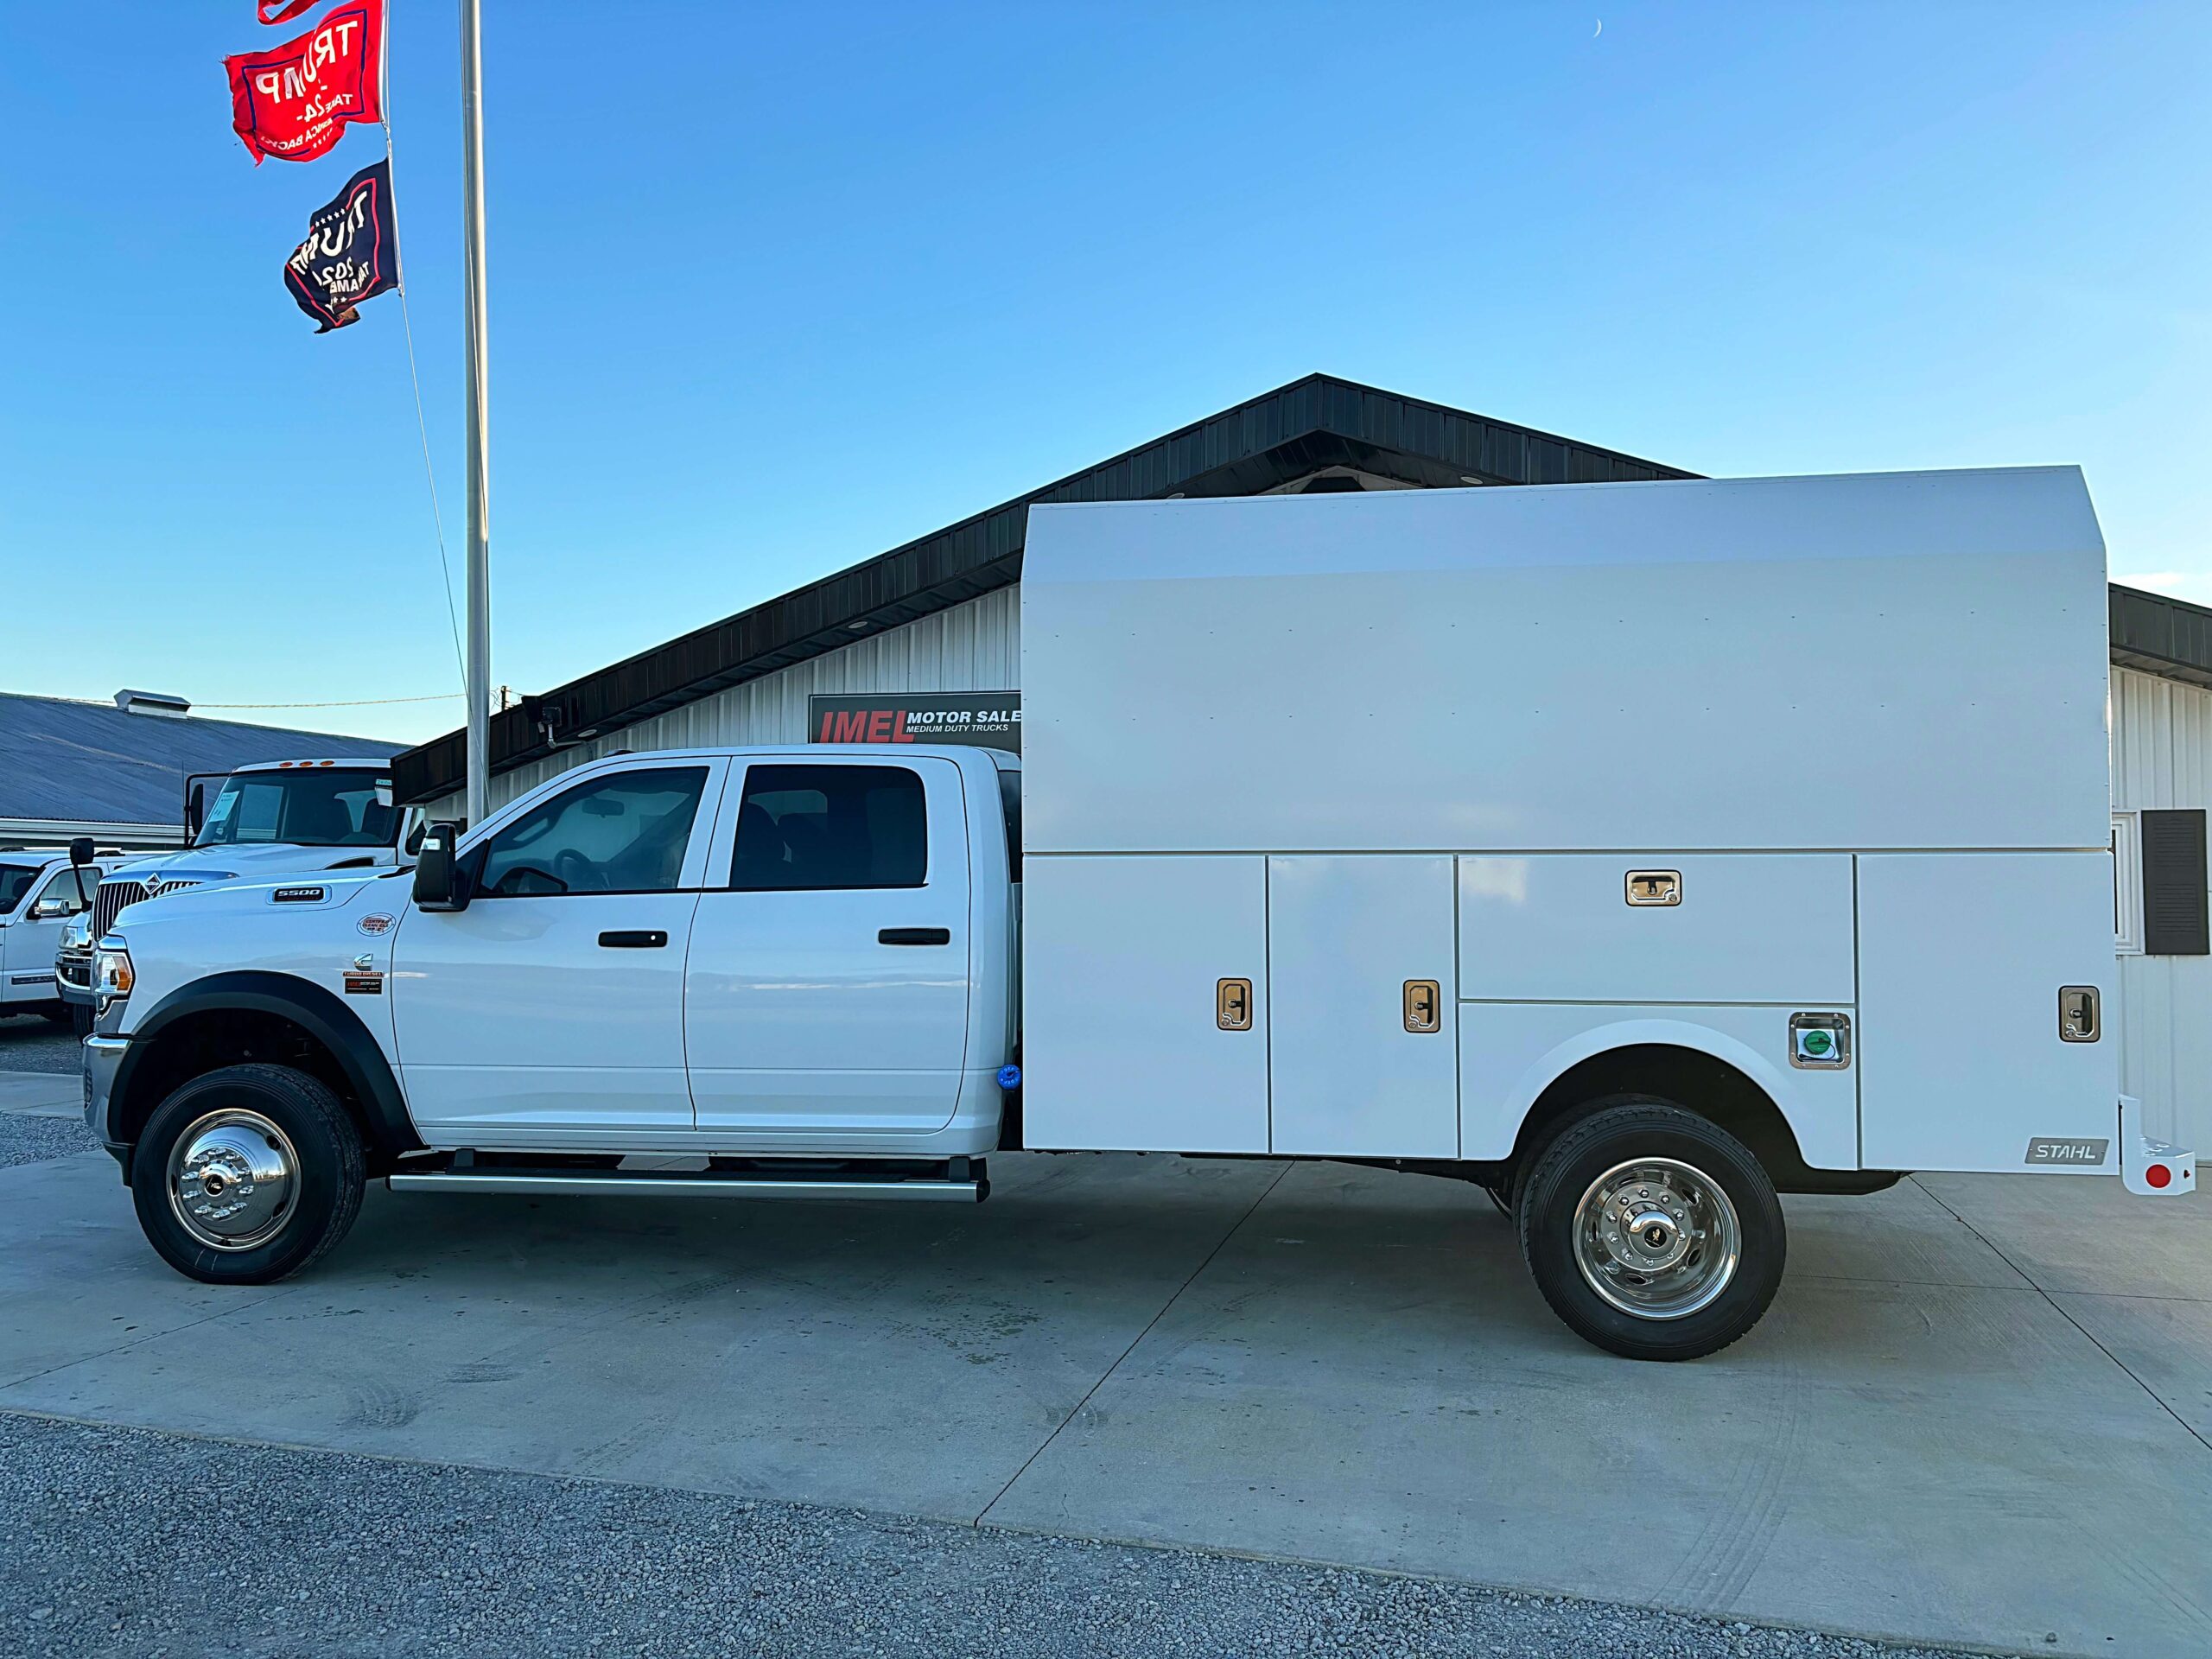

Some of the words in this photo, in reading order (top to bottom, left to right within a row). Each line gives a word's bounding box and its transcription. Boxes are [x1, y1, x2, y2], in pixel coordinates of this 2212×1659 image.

[819, 709, 916, 744] IMEL
[907, 711, 972, 724] MOTOR
[976, 709, 1021, 722] SALE
[944, 724, 969, 733] DUTY
[971, 723, 1009, 732] TRUCKS
[2035, 1144, 2096, 1160] STAHL
